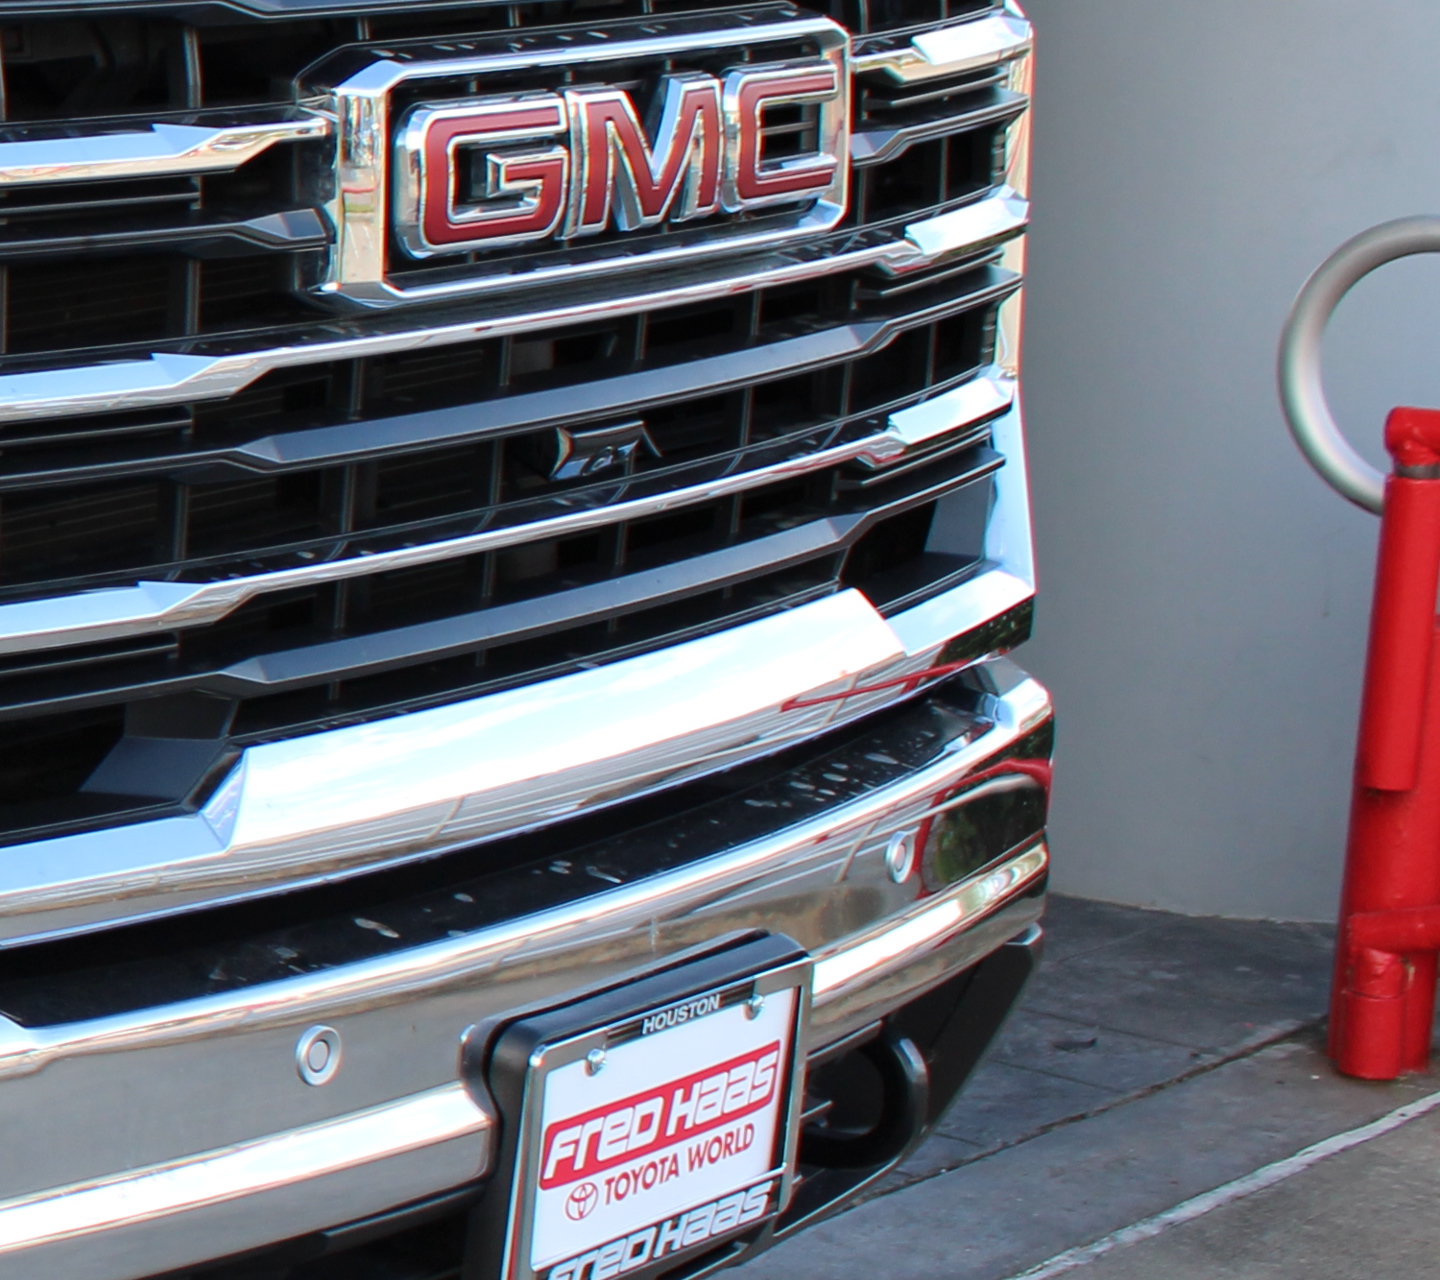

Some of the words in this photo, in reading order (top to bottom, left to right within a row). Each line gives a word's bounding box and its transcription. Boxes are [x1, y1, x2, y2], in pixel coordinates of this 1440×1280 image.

[396, 60, 839, 258] GMC
[642, 995, 720, 1035] HOUSTON
[605, 1158, 679, 1205] TOYOTA
[687, 1123, 754, 1172] WORLD
